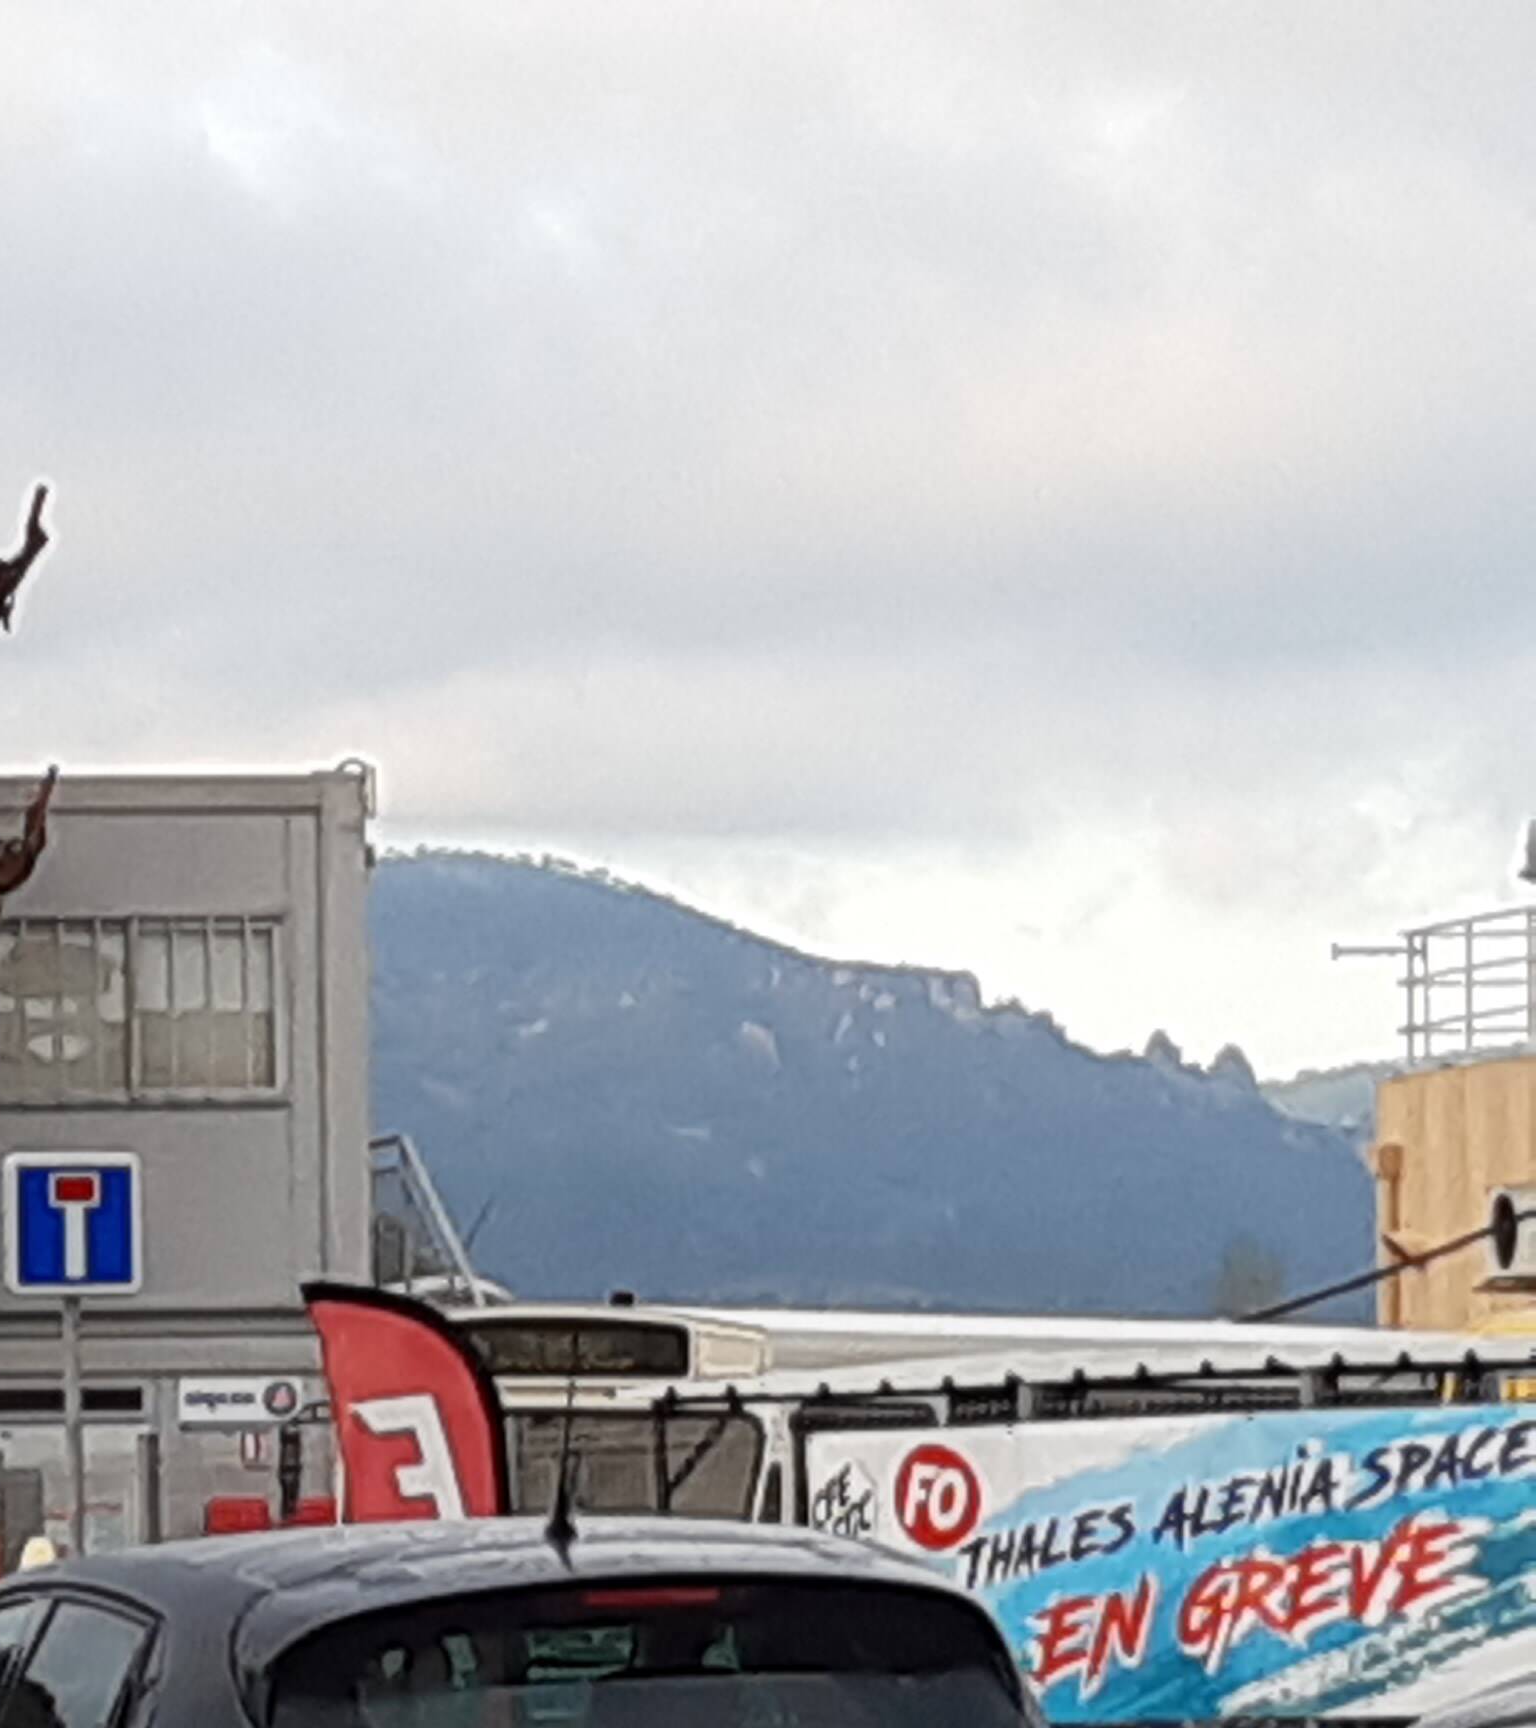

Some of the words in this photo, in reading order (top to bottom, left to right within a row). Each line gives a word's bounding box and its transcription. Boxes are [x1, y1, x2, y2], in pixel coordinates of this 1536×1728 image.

[904, 1462, 968, 1532] FO
[959, 1503, 1135, 1588] THALES
[1344, 1420, 1536, 1511] SPACE
[1033, 1573, 1150, 1681] EN
